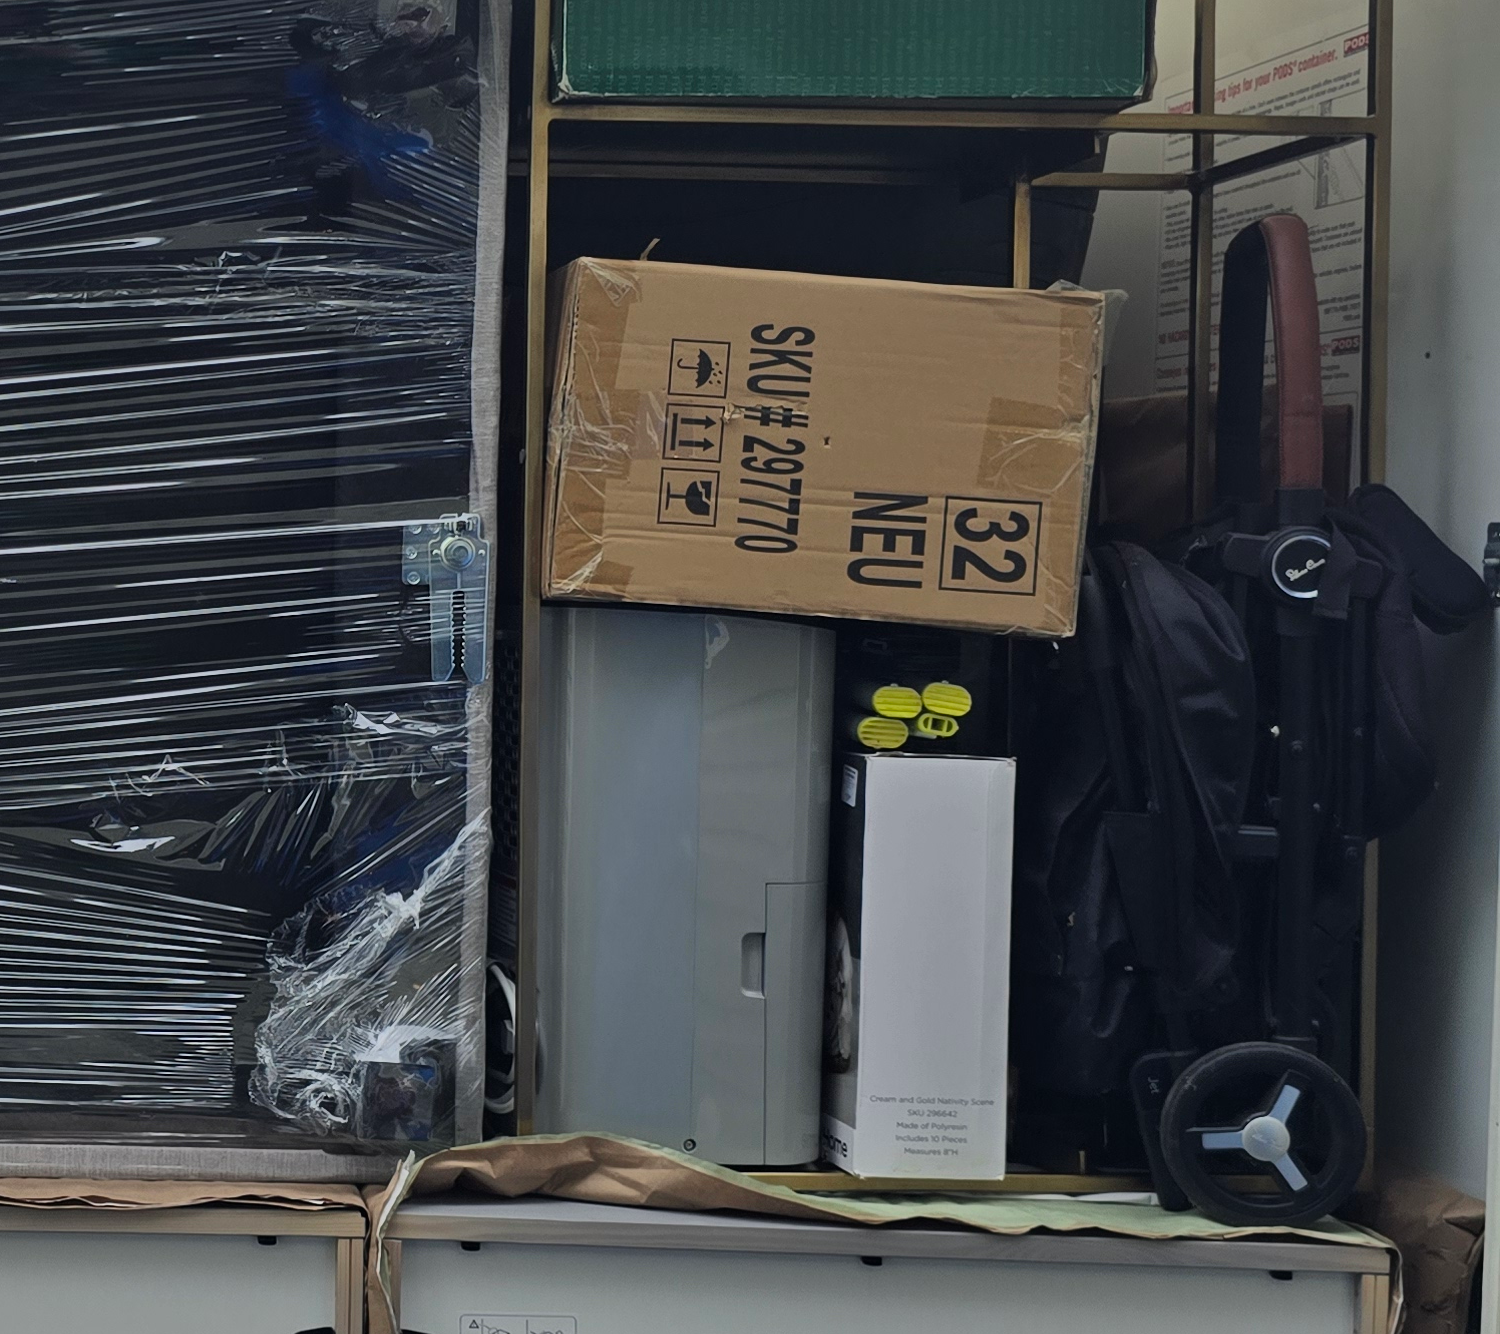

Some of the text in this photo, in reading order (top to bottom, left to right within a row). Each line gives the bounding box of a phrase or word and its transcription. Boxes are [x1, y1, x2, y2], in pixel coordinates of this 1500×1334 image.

[746, 323, 816, 398] SKU
[734, 435, 806, 554] 297770
[846, 491, 930, 590] NEU
[950, 507, 1032, 585] 32
[869, 1094, 995, 1107] Cream and Gold Nativity Scene
[906, 1109, 925, 1117] SKU
[895, 1121, 919, 1130] Made
[920, 1121, 930, 1130] of
[894, 1134, 929, 1143] Includes
[941, 1135, 968, 1144] Pieces
[903, 1146, 942, 1156] Measures
